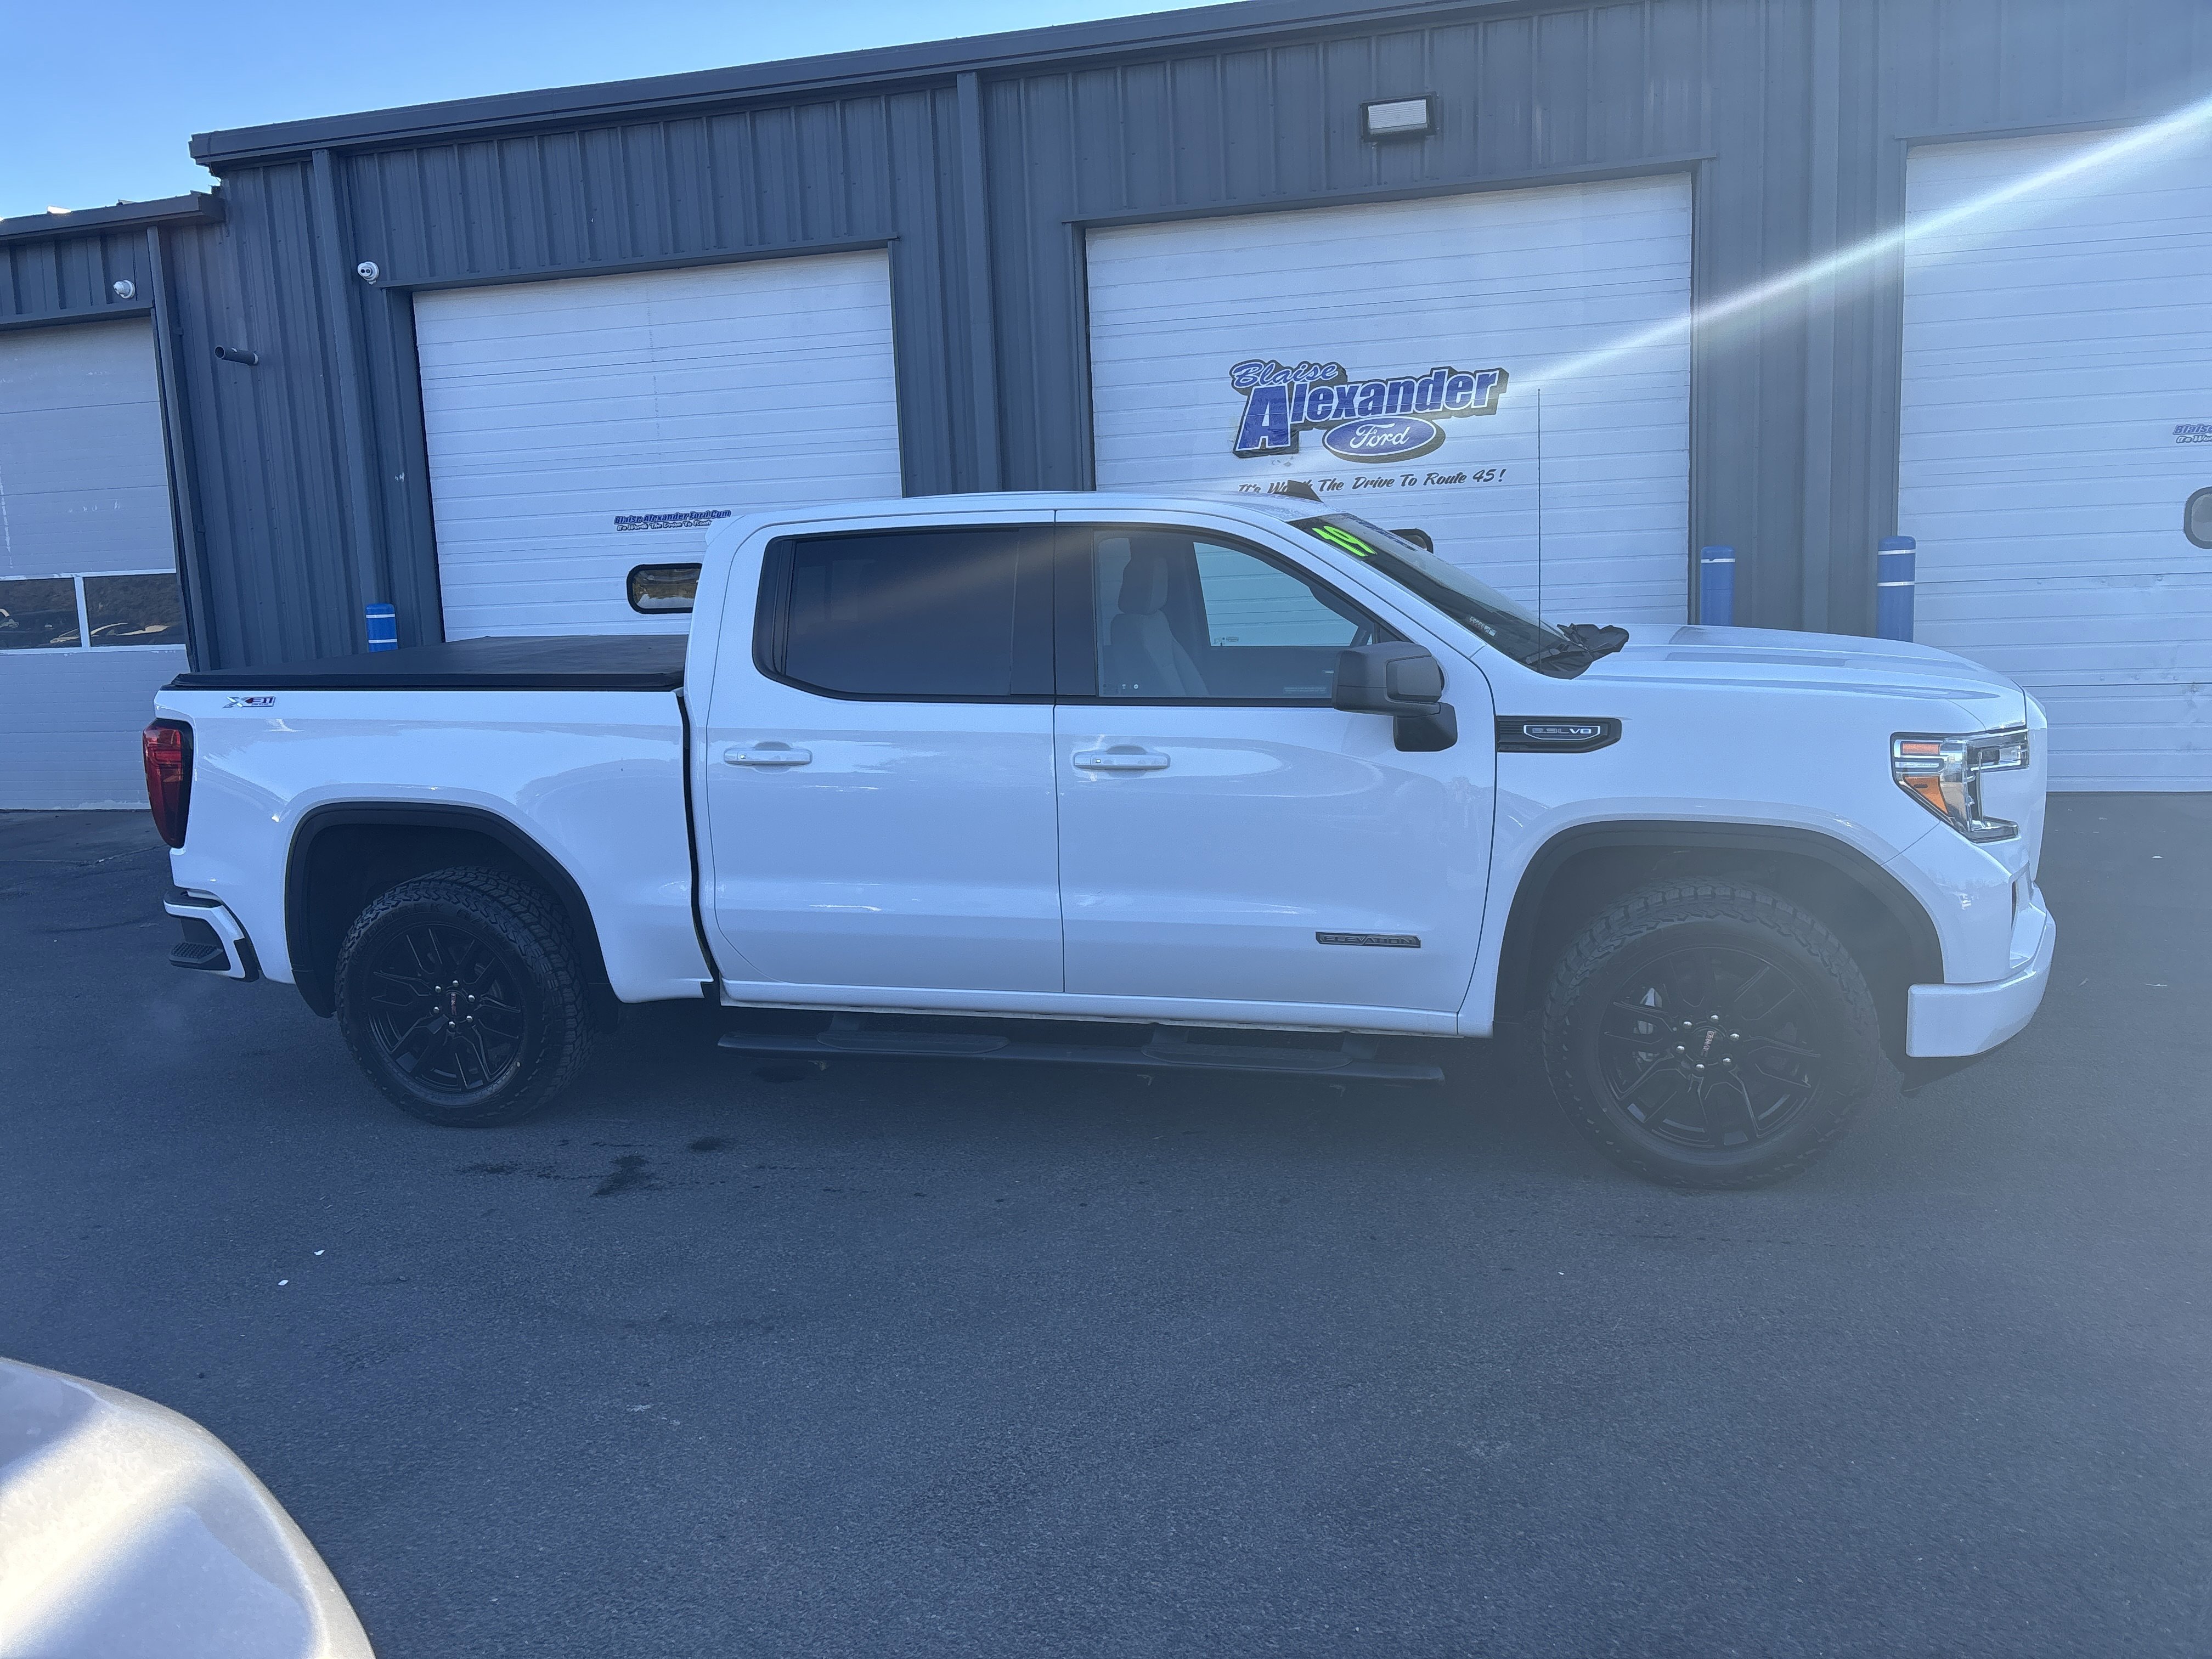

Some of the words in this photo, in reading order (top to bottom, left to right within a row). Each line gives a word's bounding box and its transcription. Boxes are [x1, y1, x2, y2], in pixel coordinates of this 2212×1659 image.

[1231, 360, 1340, 388] Blaise
[1235, 368, 1501, 452] Alexander
[1349, 422, 1412, 449] Ford
[1318, 478, 1344, 492] The
[1353, 475, 1393, 490] Drive
[1400, 473, 1419, 487] To
[1423, 471, 1466, 486] Route
[1472, 469, 1506, 483] 45!
[614, 515, 643, 524] Blaise
[643, 512, 689, 523] Alexander
[1323, 935, 1414, 944] ELEVATION
[1701, 1030, 1715, 1057] GMC
